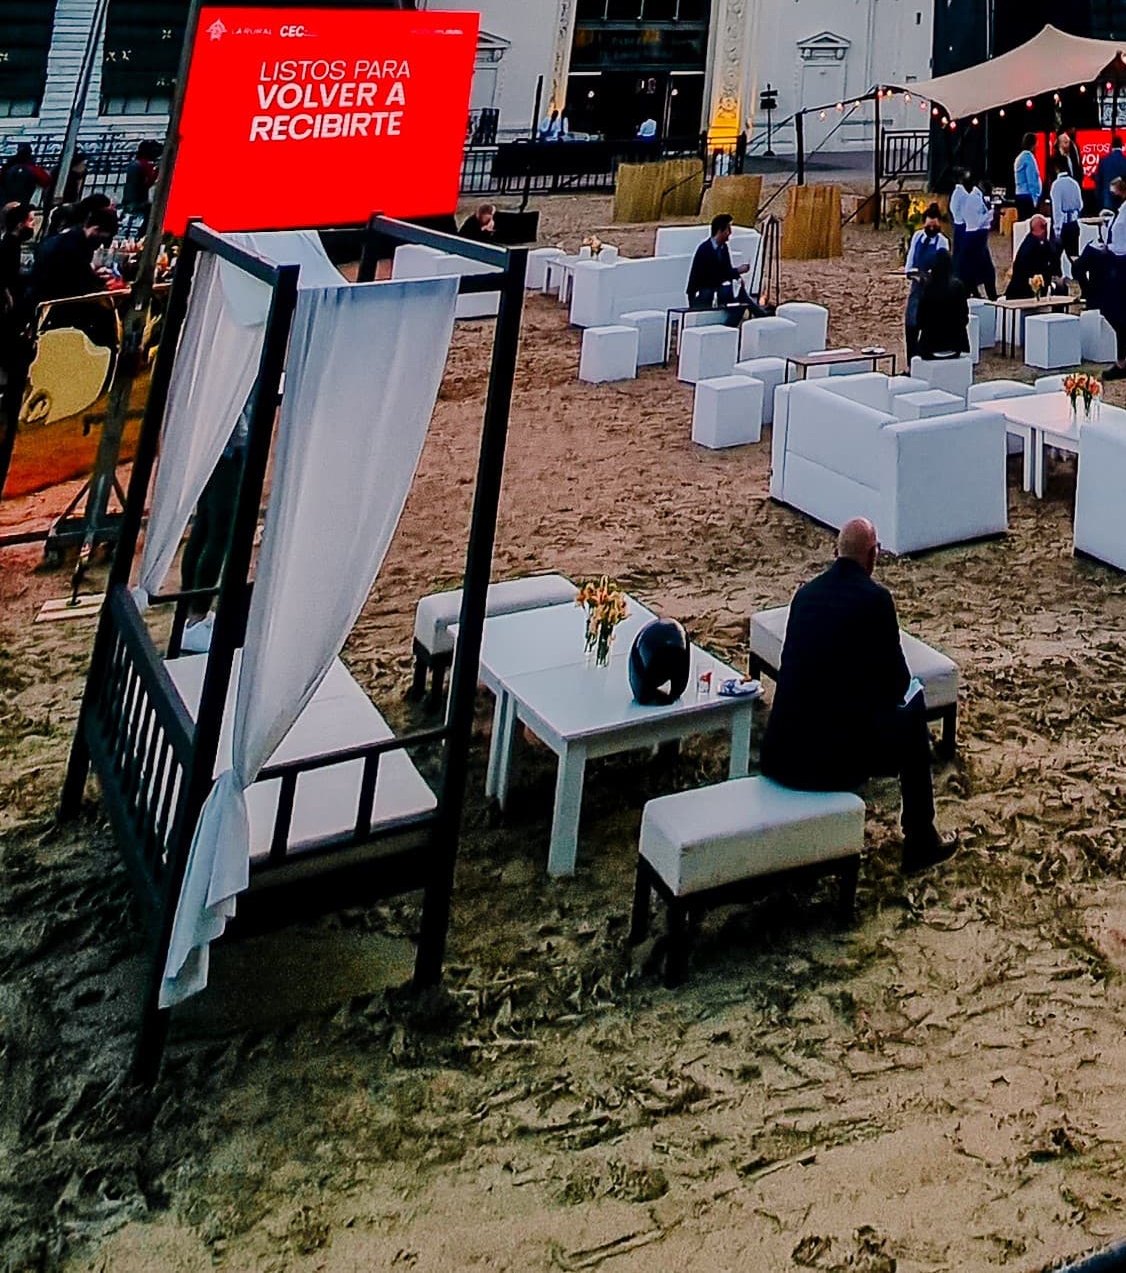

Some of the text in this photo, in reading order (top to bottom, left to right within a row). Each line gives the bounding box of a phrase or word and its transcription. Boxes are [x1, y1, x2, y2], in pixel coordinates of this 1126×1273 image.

[279, 25, 305, 38] CEC
[259, 59, 411, 82] LISTOS PARA
[256, 81, 406, 110] VOLVER A
[248, 110, 404, 142] RECIBIRTE
